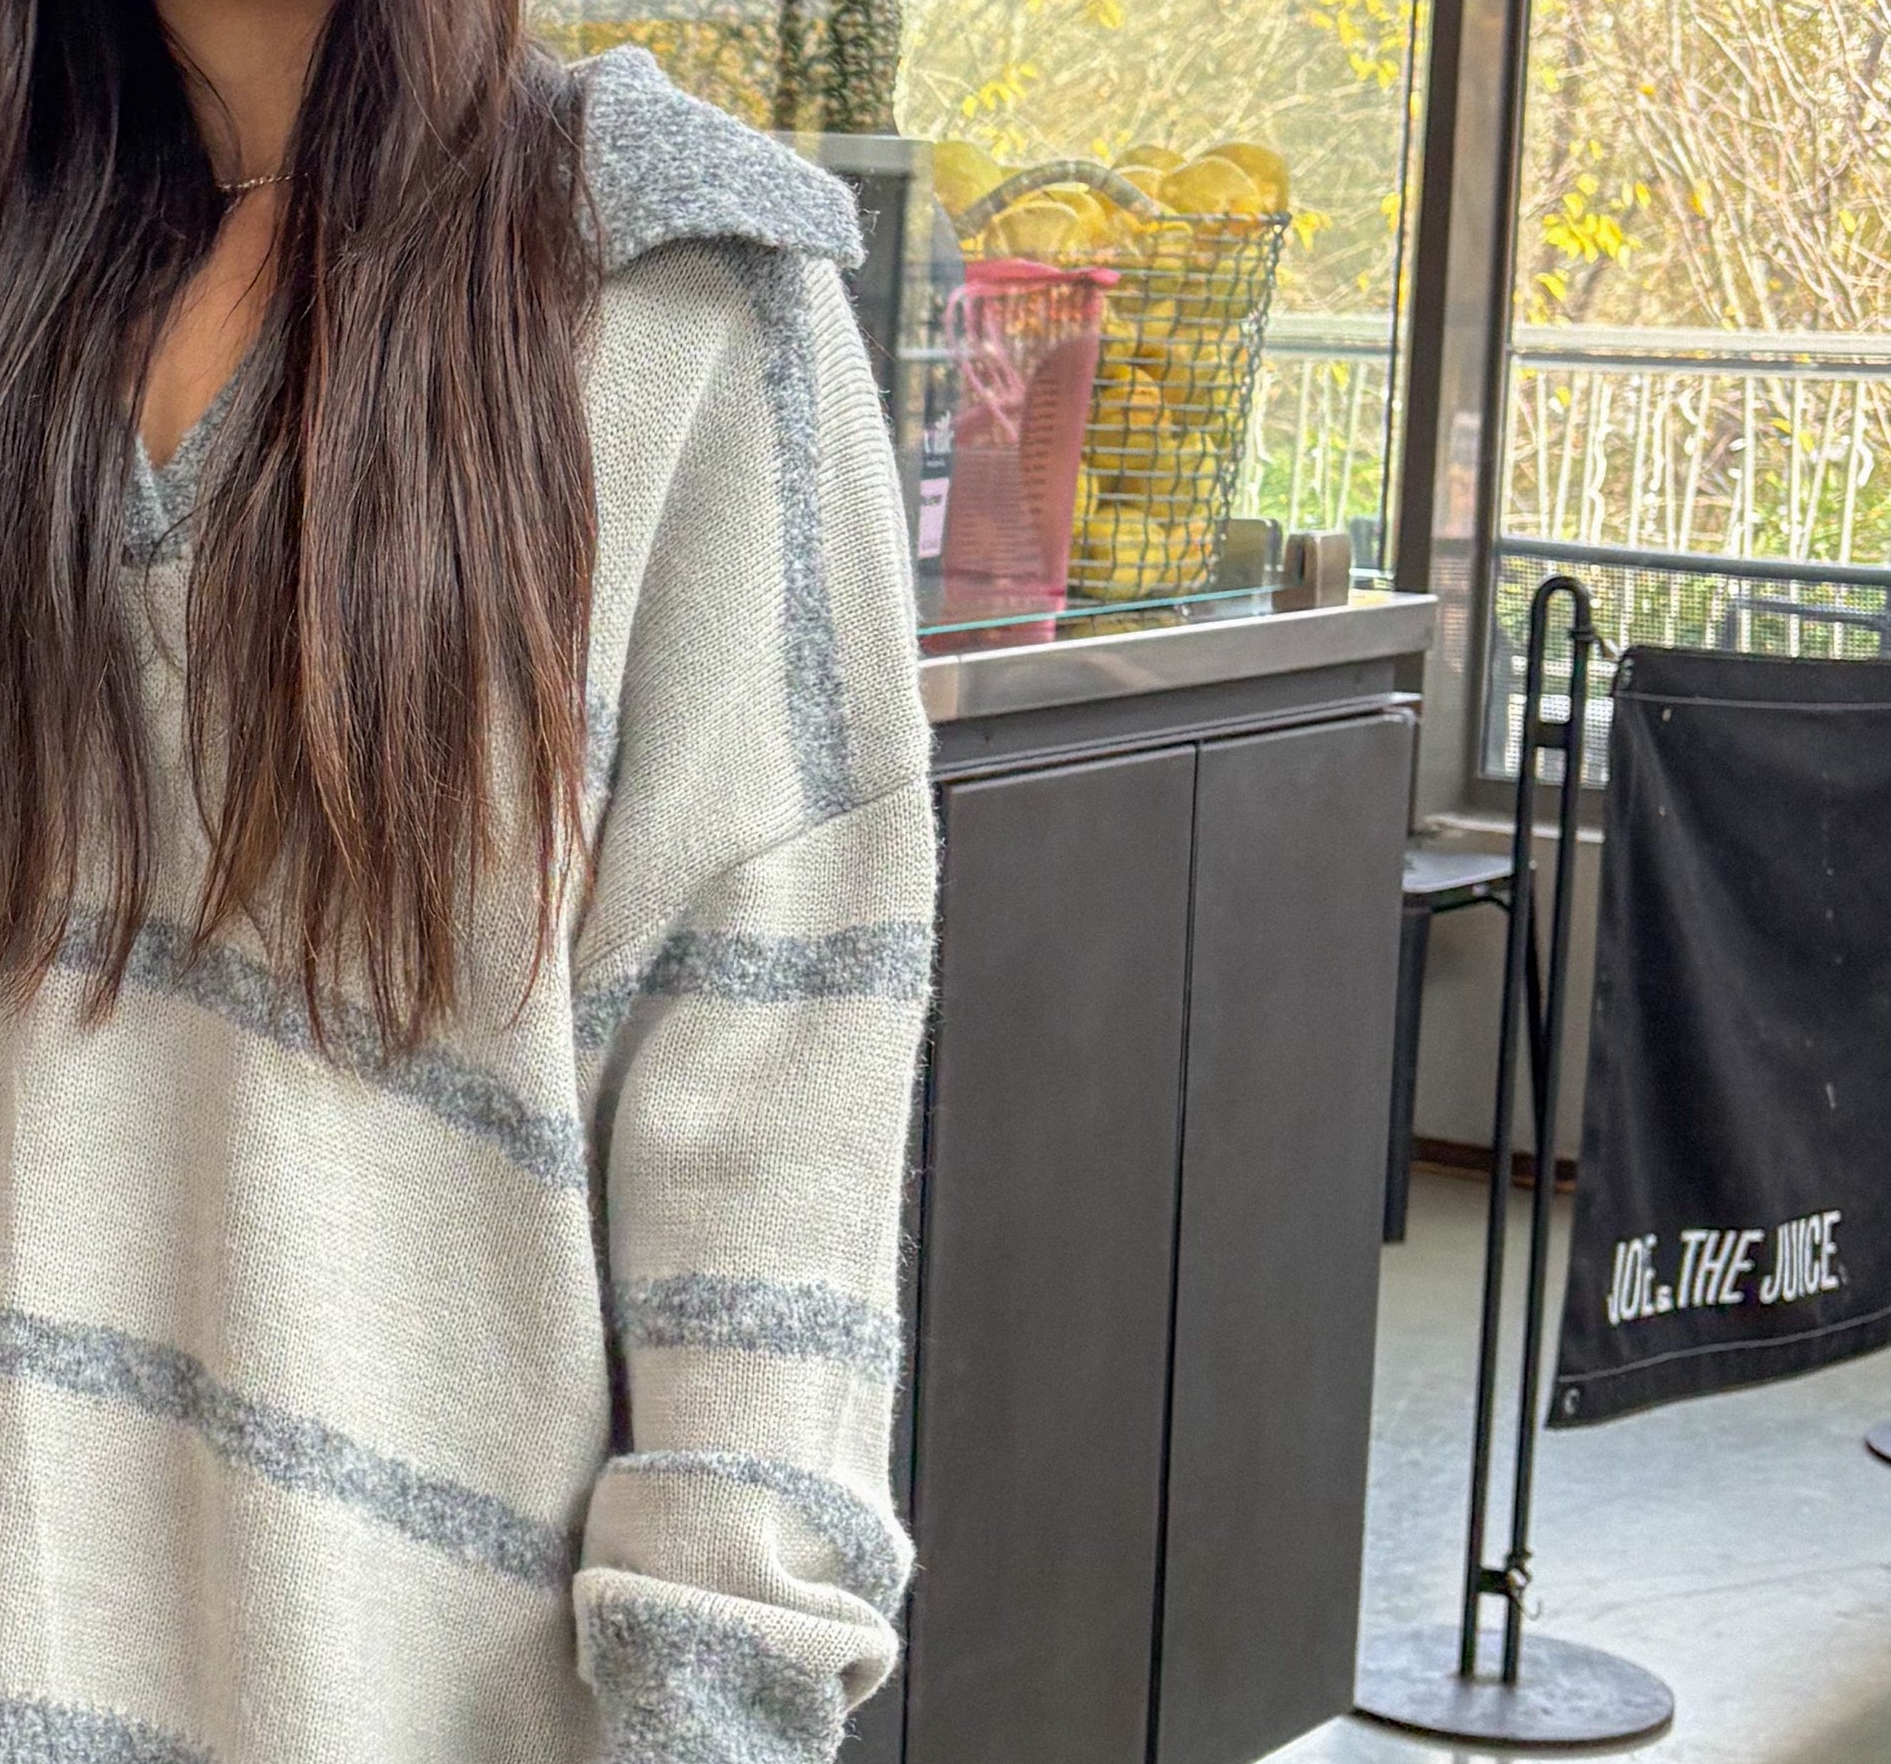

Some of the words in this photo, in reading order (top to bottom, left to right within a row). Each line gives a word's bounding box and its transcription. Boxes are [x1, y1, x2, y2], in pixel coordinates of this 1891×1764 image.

[1607, 1232, 1658, 1327] JOE
[1676, 1228, 1766, 1309] THE
[1759, 1209, 1843, 1306] JUICE
